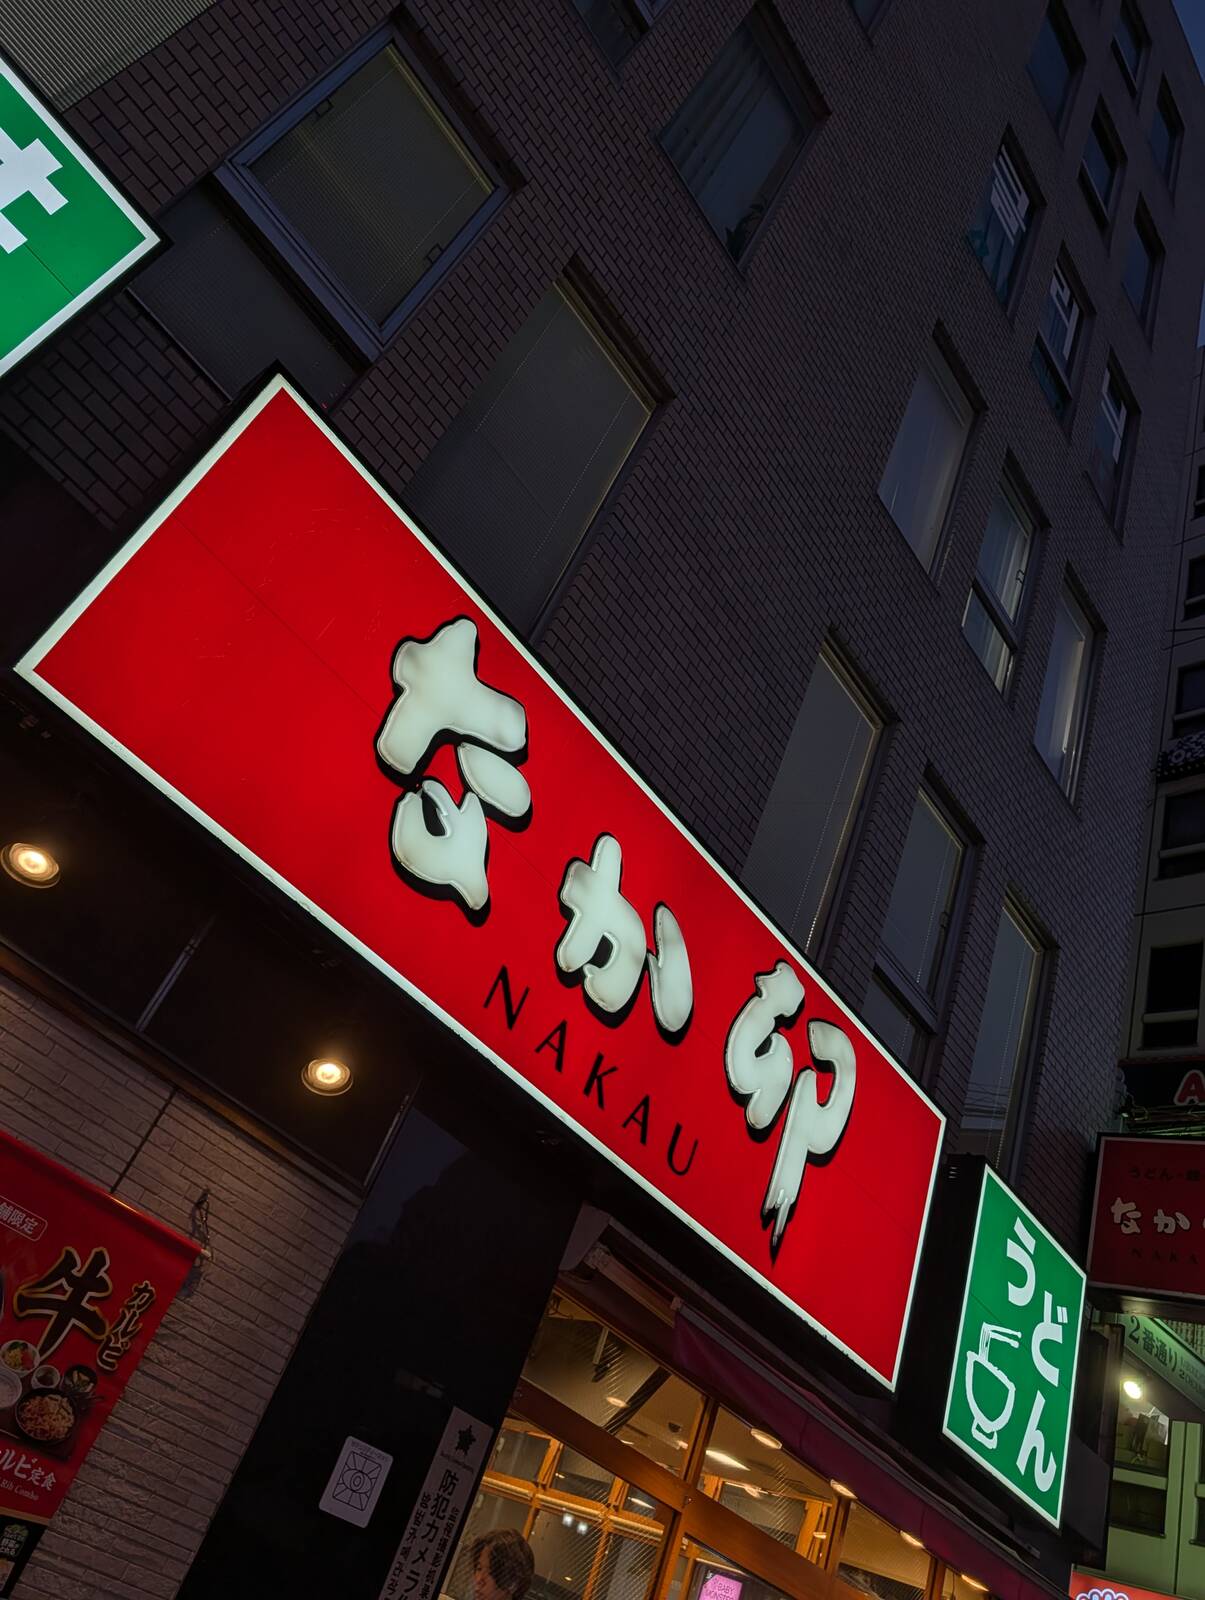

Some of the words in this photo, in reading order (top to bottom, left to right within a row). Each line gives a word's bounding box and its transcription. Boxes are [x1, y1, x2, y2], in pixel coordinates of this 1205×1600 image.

[375, 617, 857, 1255] なか卯
[483, 965, 699, 1177] NAKAU
[1111, 1197, 1205, 1235] なか
[13, 1246, 112, 1363] 牛
[97, 1280, 156, 1371] カルビ
[1007, 1217, 1069, 1492] うどん
[1128, 1315, 1178, 1373] 2番通り
[0, 1449, 56, 1491] ルビ定食
[401, 1469, 459, 1600] 防犯カメラ
